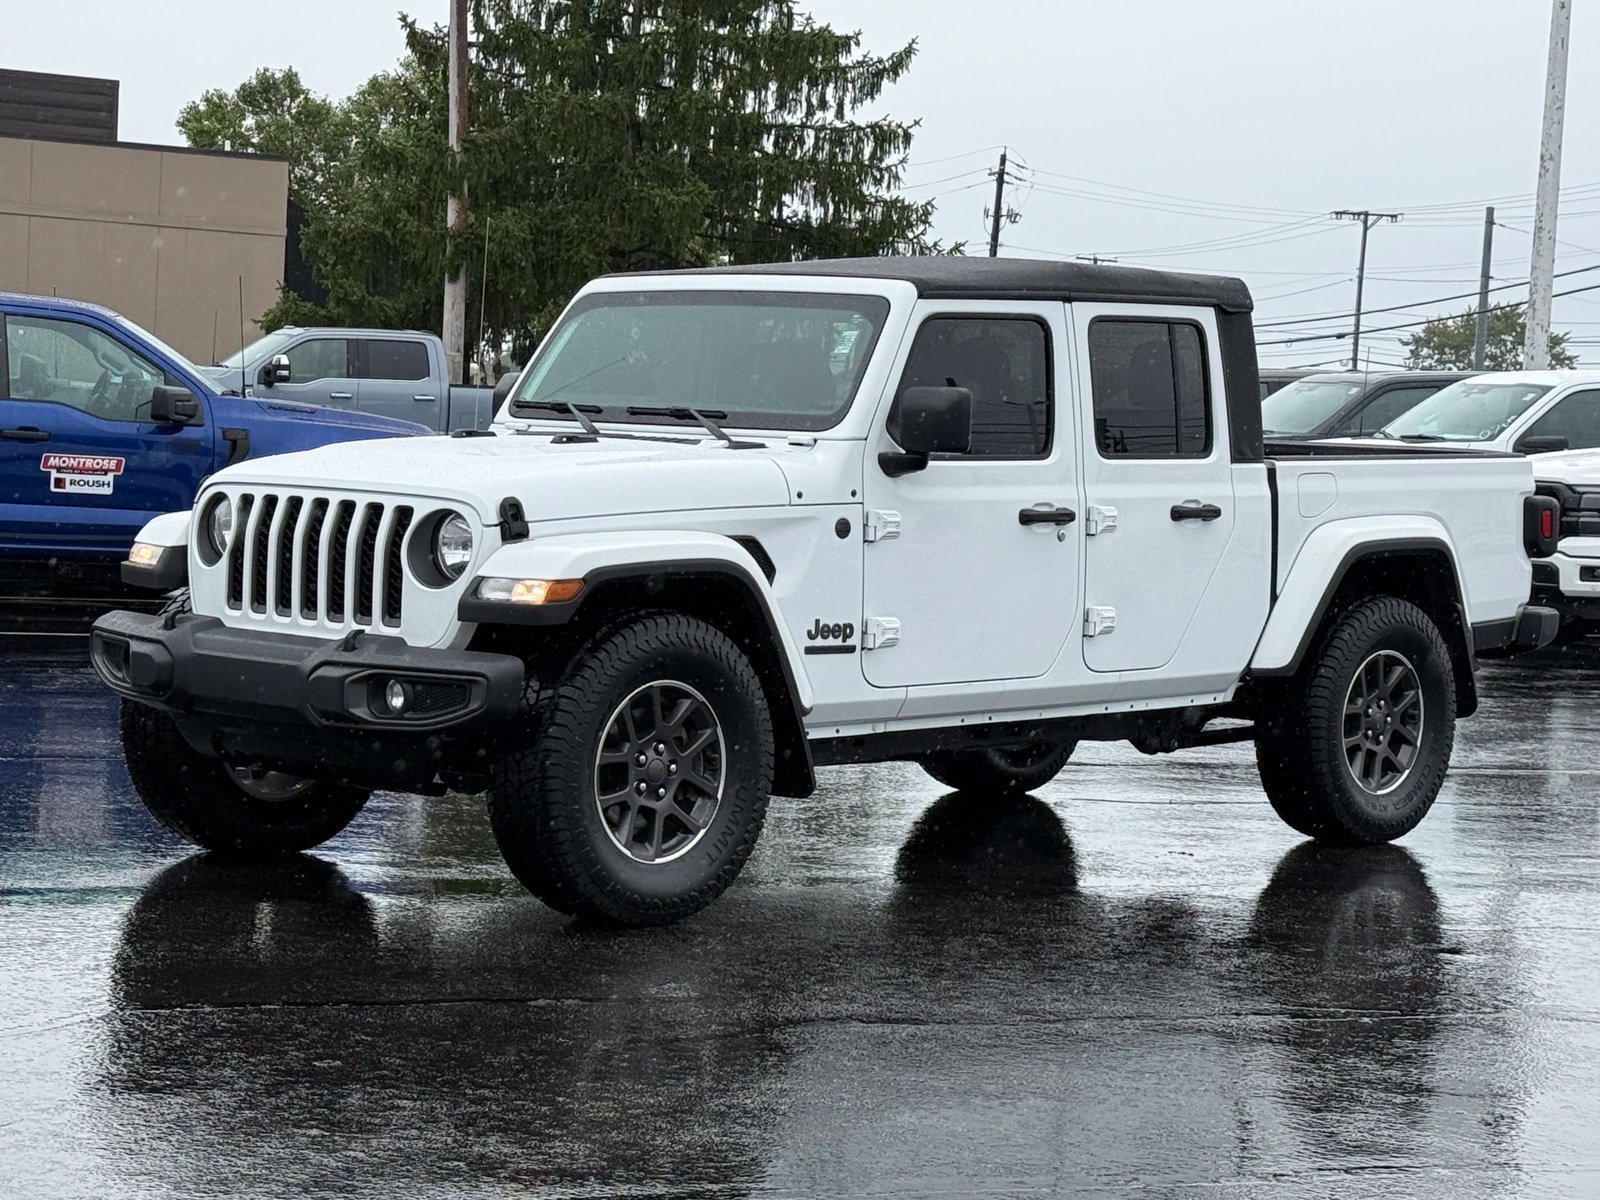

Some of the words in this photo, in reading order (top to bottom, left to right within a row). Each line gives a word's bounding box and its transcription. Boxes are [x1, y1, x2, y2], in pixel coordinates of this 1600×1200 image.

[47, 456, 117, 470] MONTROSE
[69, 479, 111, 488] ROUSH
[807, 618, 854, 643] Jeep
